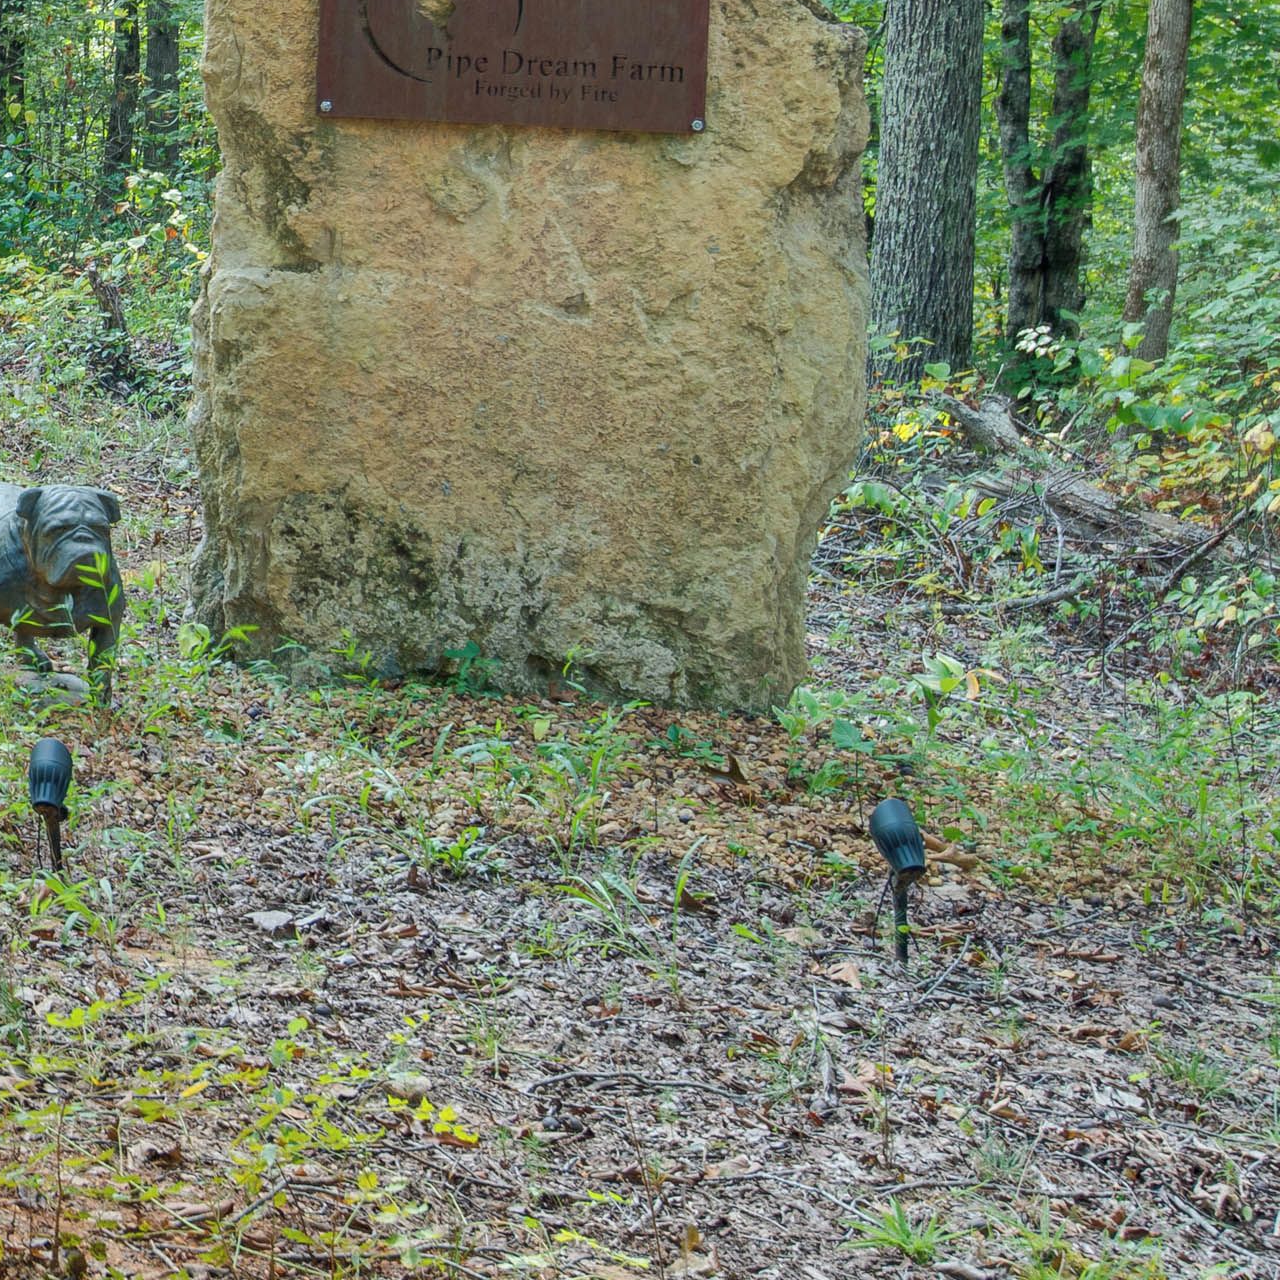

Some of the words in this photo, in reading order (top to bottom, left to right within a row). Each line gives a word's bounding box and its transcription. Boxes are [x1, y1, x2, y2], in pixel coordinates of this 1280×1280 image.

[427, 47, 488, 78] Pipe
[502, 50, 596, 79] Dream
[611, 56, 684, 83] Farm
[474, 79, 541, 99] Forged
[549, 83, 573, 103] by
[581, 85, 618, 102] Fire
